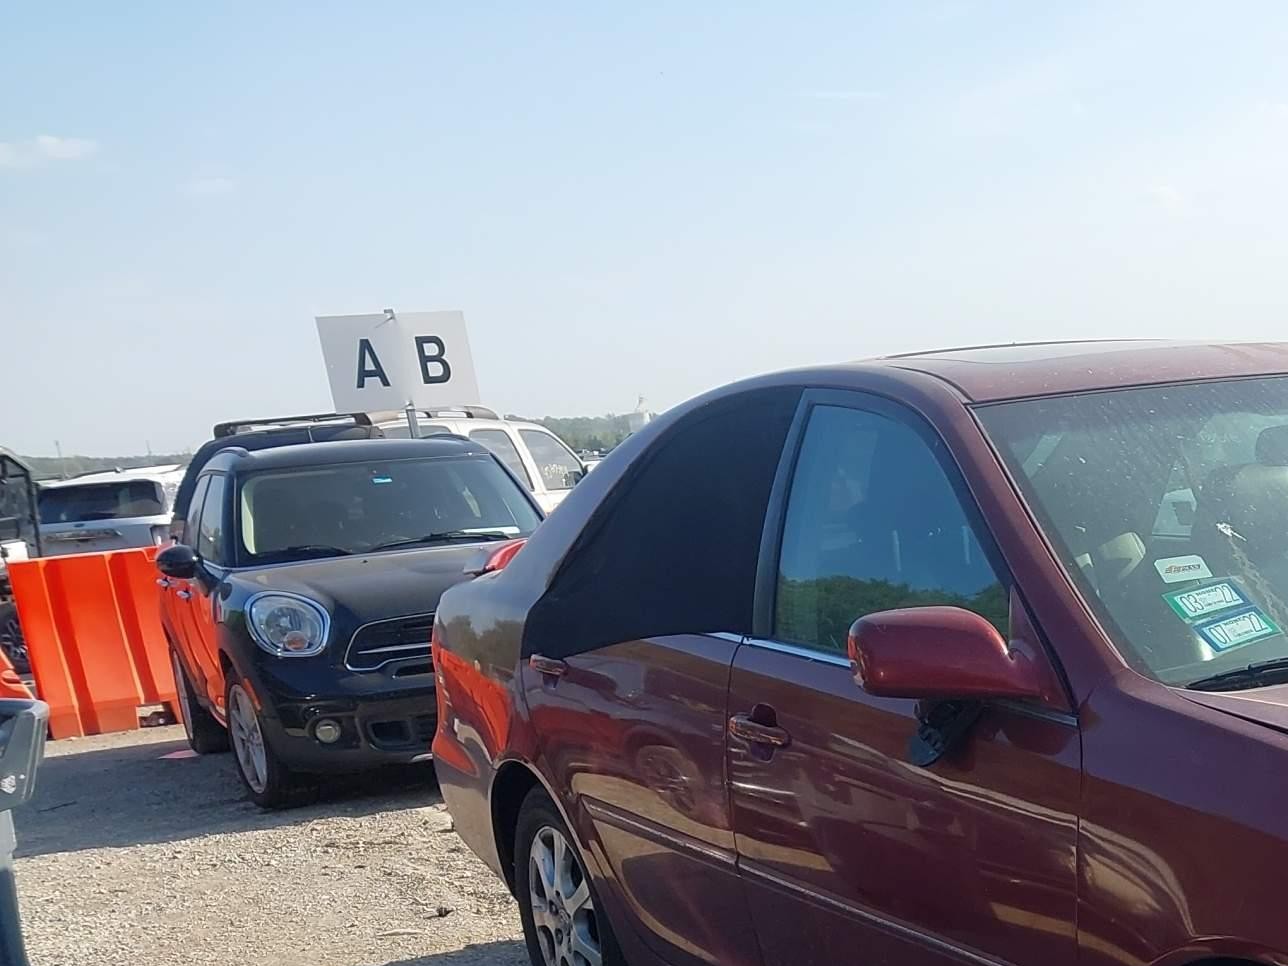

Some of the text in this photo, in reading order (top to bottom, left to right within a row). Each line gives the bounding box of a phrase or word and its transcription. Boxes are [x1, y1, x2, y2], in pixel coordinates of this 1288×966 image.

[356, 335, 451, 388] A B
[1180, 595, 1204, 612] 03
[1215, 585, 1239, 603] 22
[1209, 625, 1232, 644] 07
[1243, 613, 1268, 632] 22
